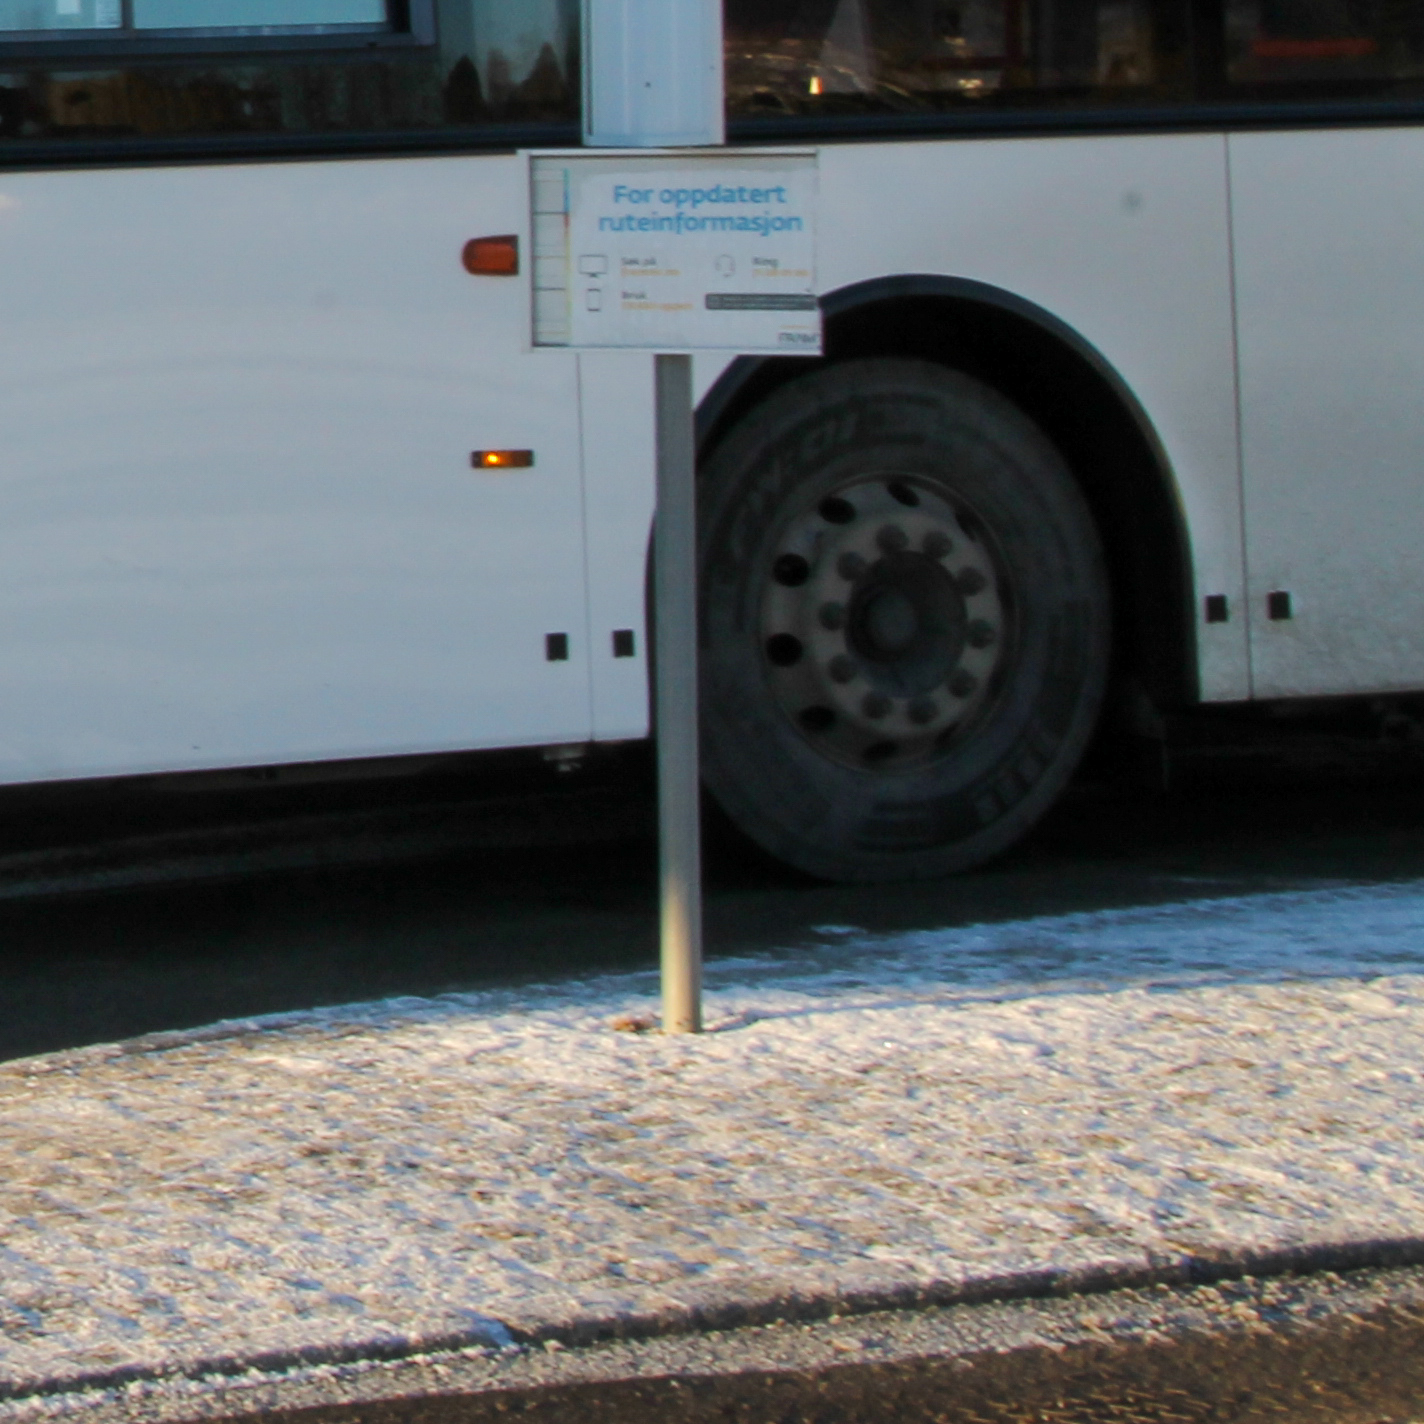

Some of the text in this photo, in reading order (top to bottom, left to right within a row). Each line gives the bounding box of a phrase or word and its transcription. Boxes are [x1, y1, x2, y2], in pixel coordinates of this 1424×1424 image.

[613, 184, 788, 209] For oppdatert
[598, 211, 804, 237] ruteinformasjon
